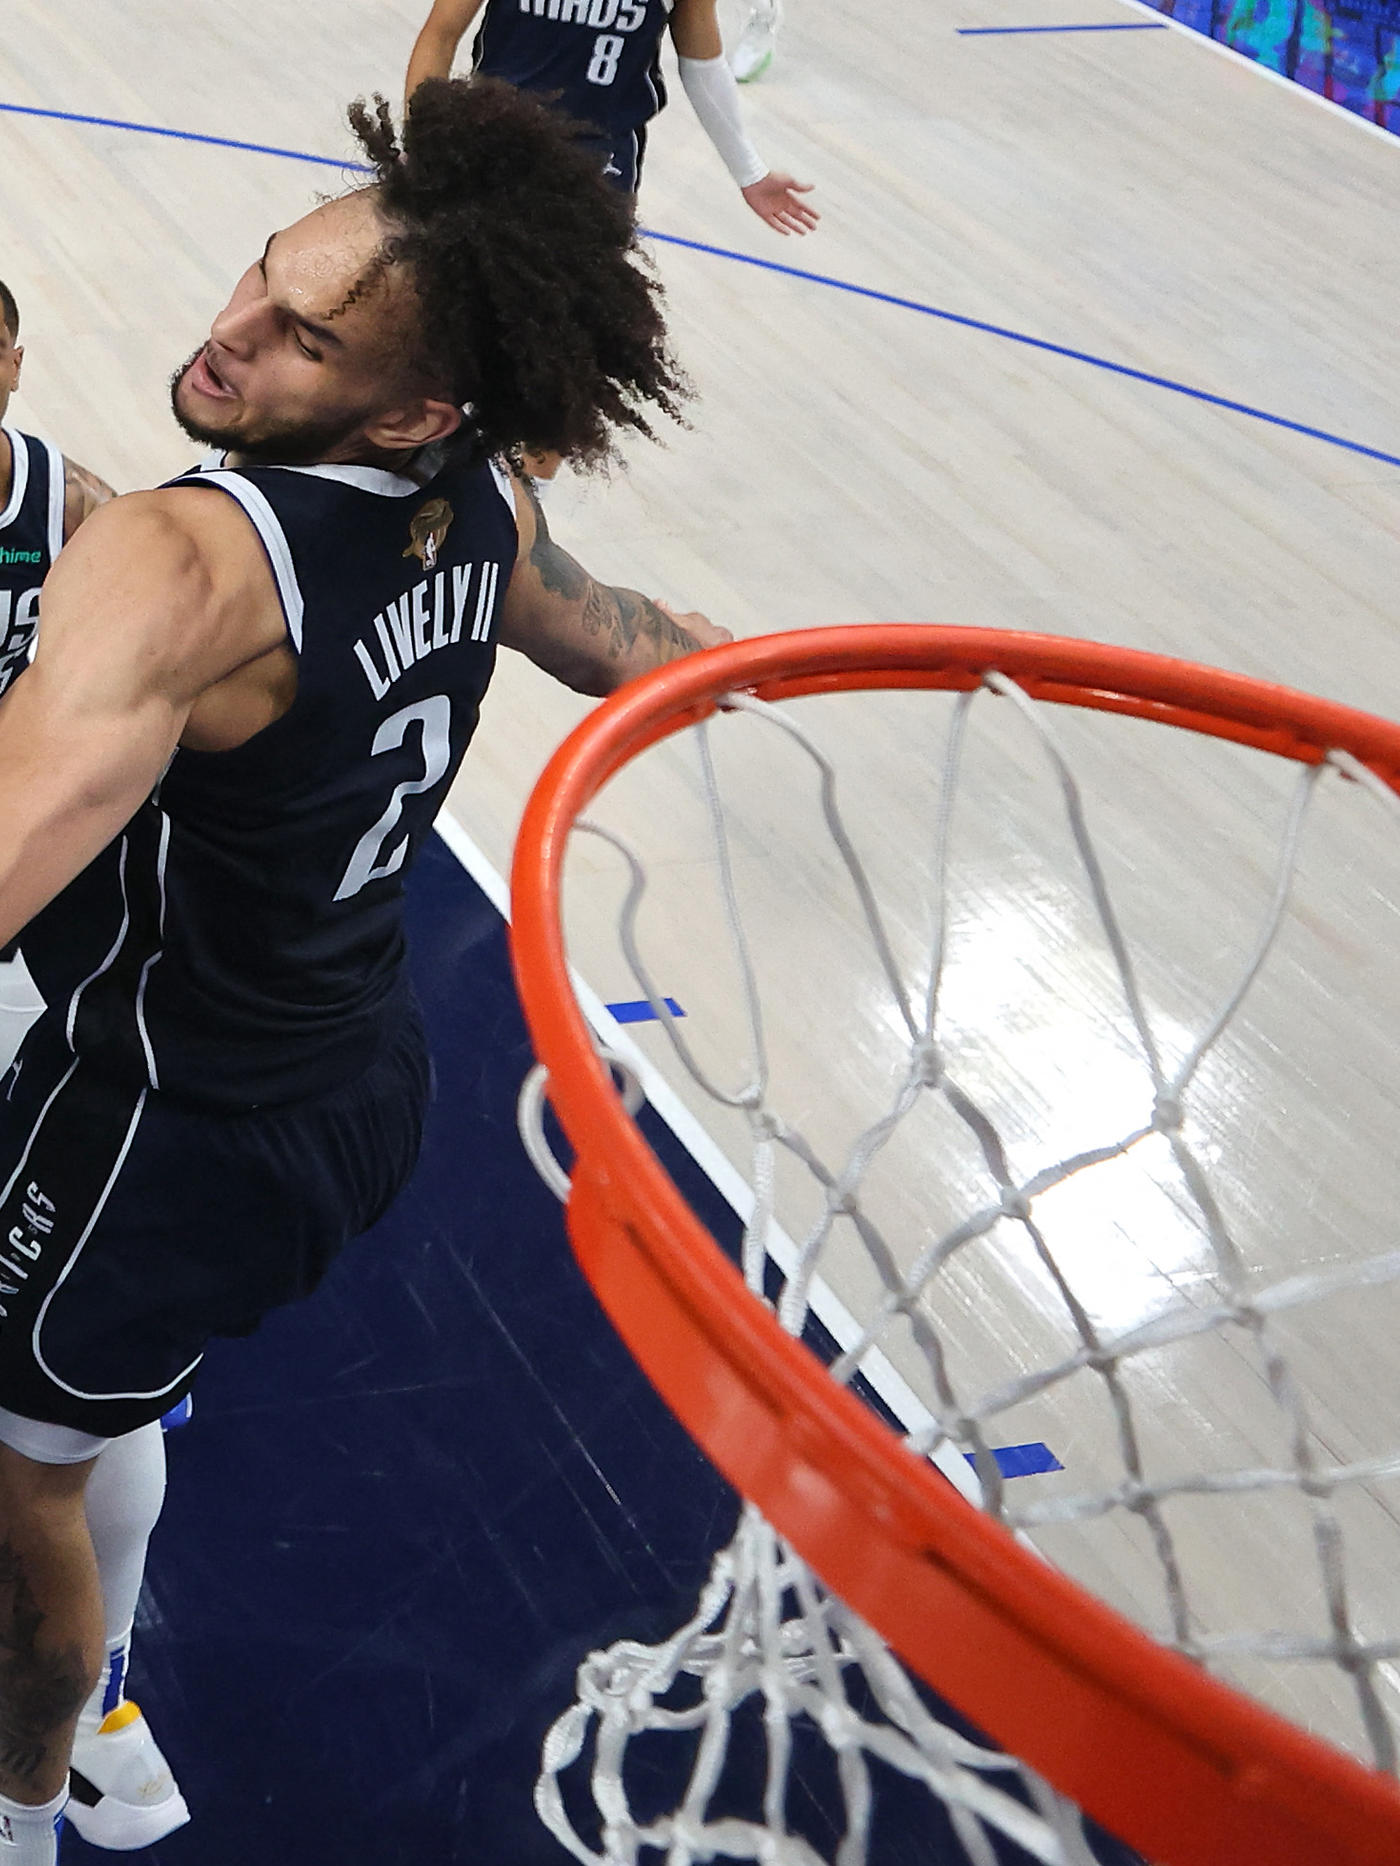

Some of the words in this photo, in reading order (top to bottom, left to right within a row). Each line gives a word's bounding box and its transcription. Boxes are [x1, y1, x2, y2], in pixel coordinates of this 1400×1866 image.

[586, 34, 626, 87] 8
[353, 562, 472, 701] LIVELY
[471, 561, 499, 643] II
[331, 694, 452, 902] 2
